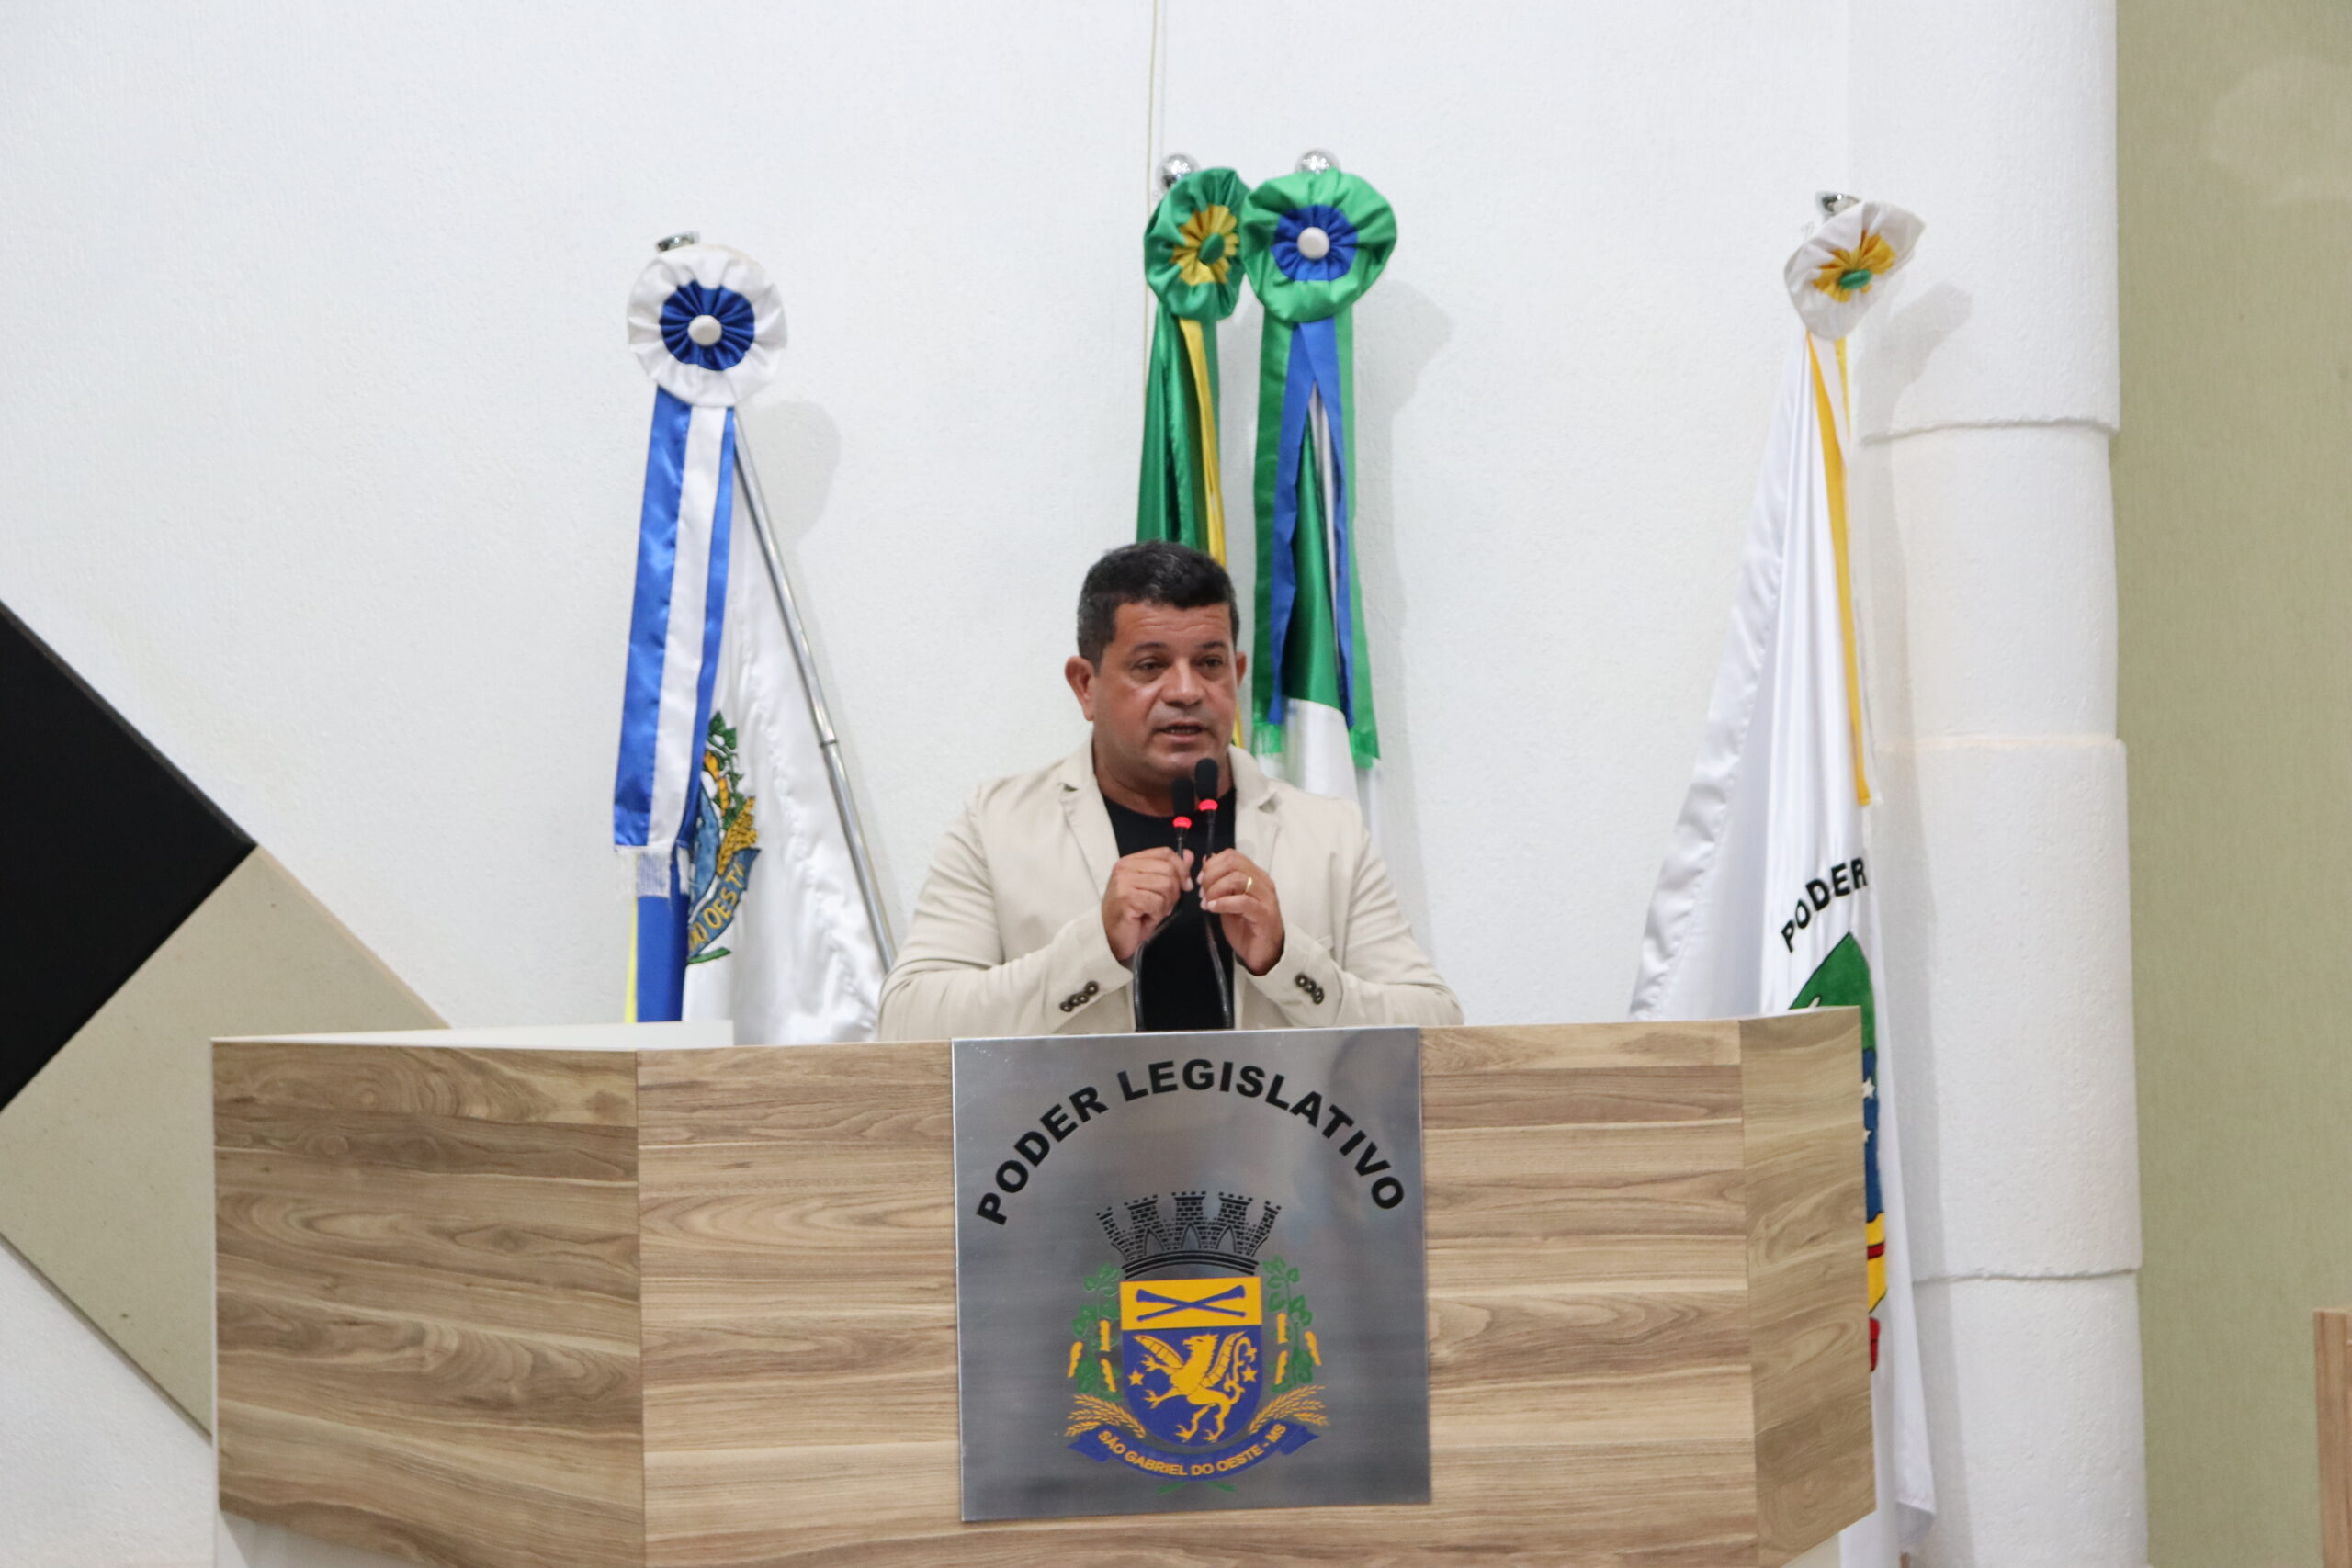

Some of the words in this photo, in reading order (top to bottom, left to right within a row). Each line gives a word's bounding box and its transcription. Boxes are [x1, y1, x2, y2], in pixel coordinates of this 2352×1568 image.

[1781, 857, 1868, 953] PODER
[976, 1085, 1109, 1226] PODER
[1117, 1058, 1406, 1211] LEGISLATIVO
[1098, 1430, 1126, 1455] SÃO
[1125, 1450, 1188, 1476] GABRIEL
[1191, 1462, 1215, 1476] DO
[1216, 1444, 1265, 1472] OESTE
[1265, 1423, 1287, 1443] MS
